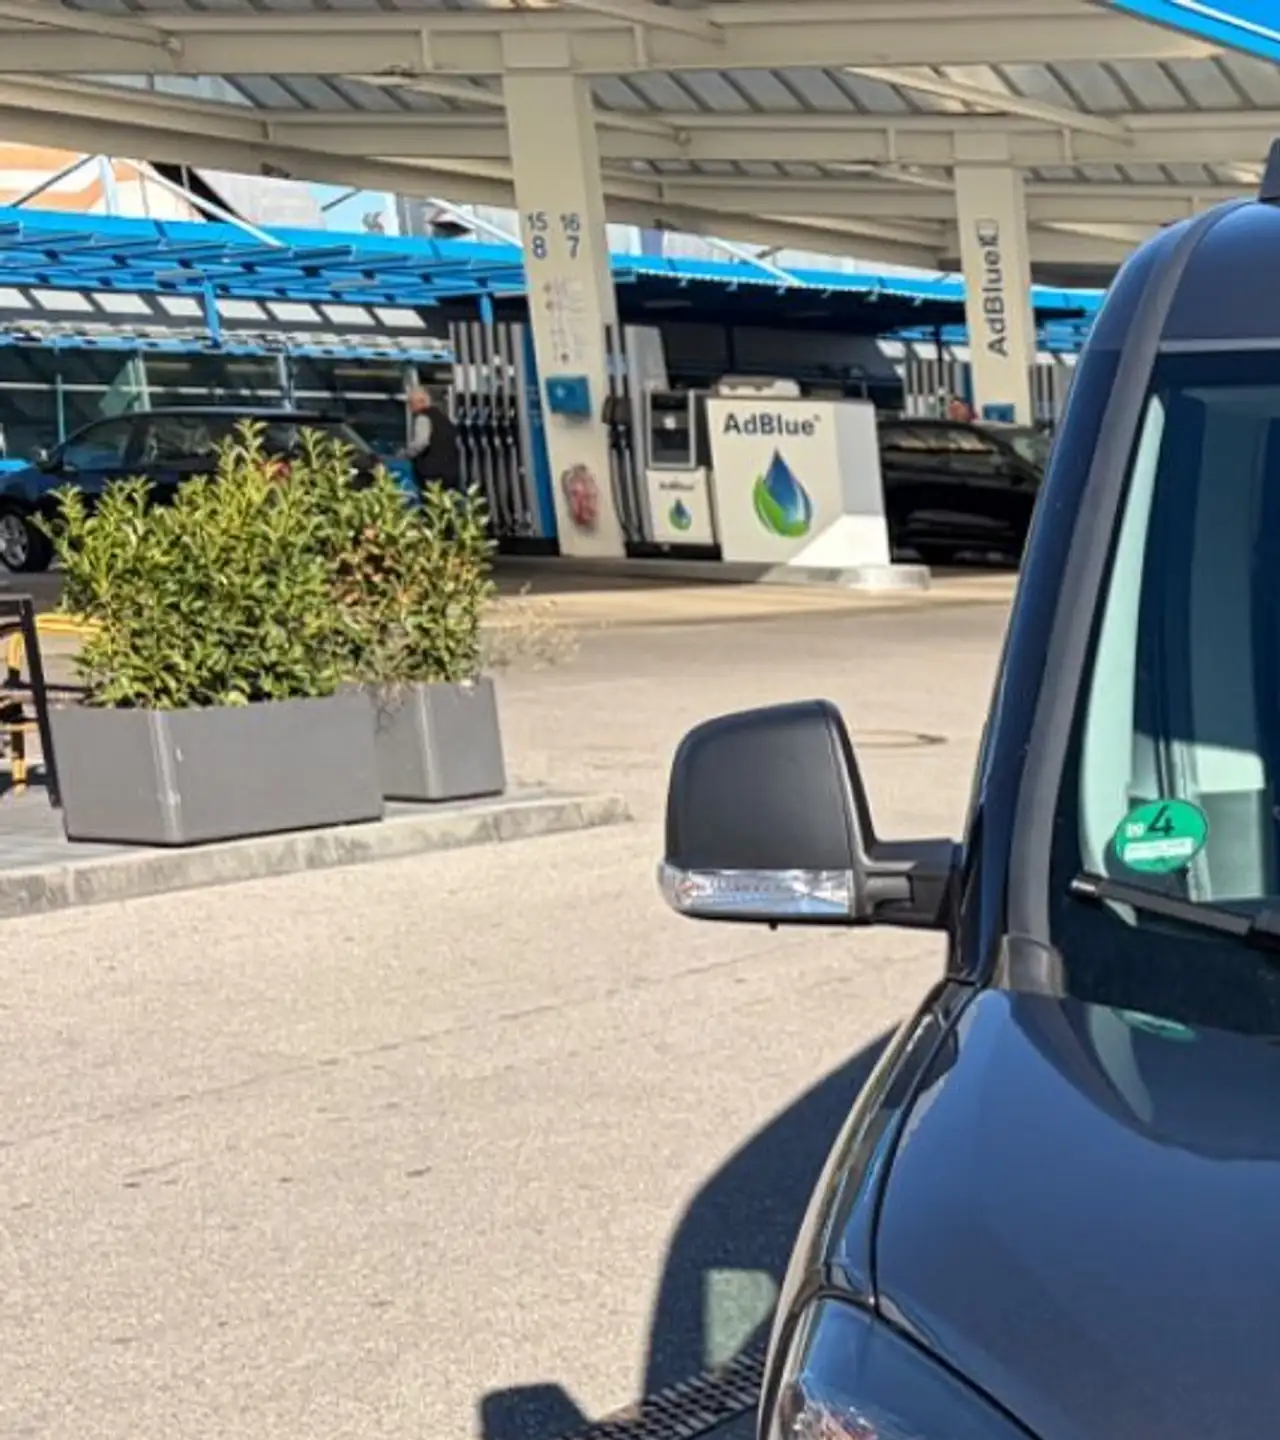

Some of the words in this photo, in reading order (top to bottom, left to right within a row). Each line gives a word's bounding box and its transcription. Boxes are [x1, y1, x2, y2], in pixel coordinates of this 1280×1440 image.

[528, 212, 548, 232] 15
[560, 213, 580, 232] 16
[532, 235, 547, 259] 8
[566, 236, 580, 259] 7
[982, 249, 1009, 358] AdBlue
[1147, 804, 1175, 836] 4
